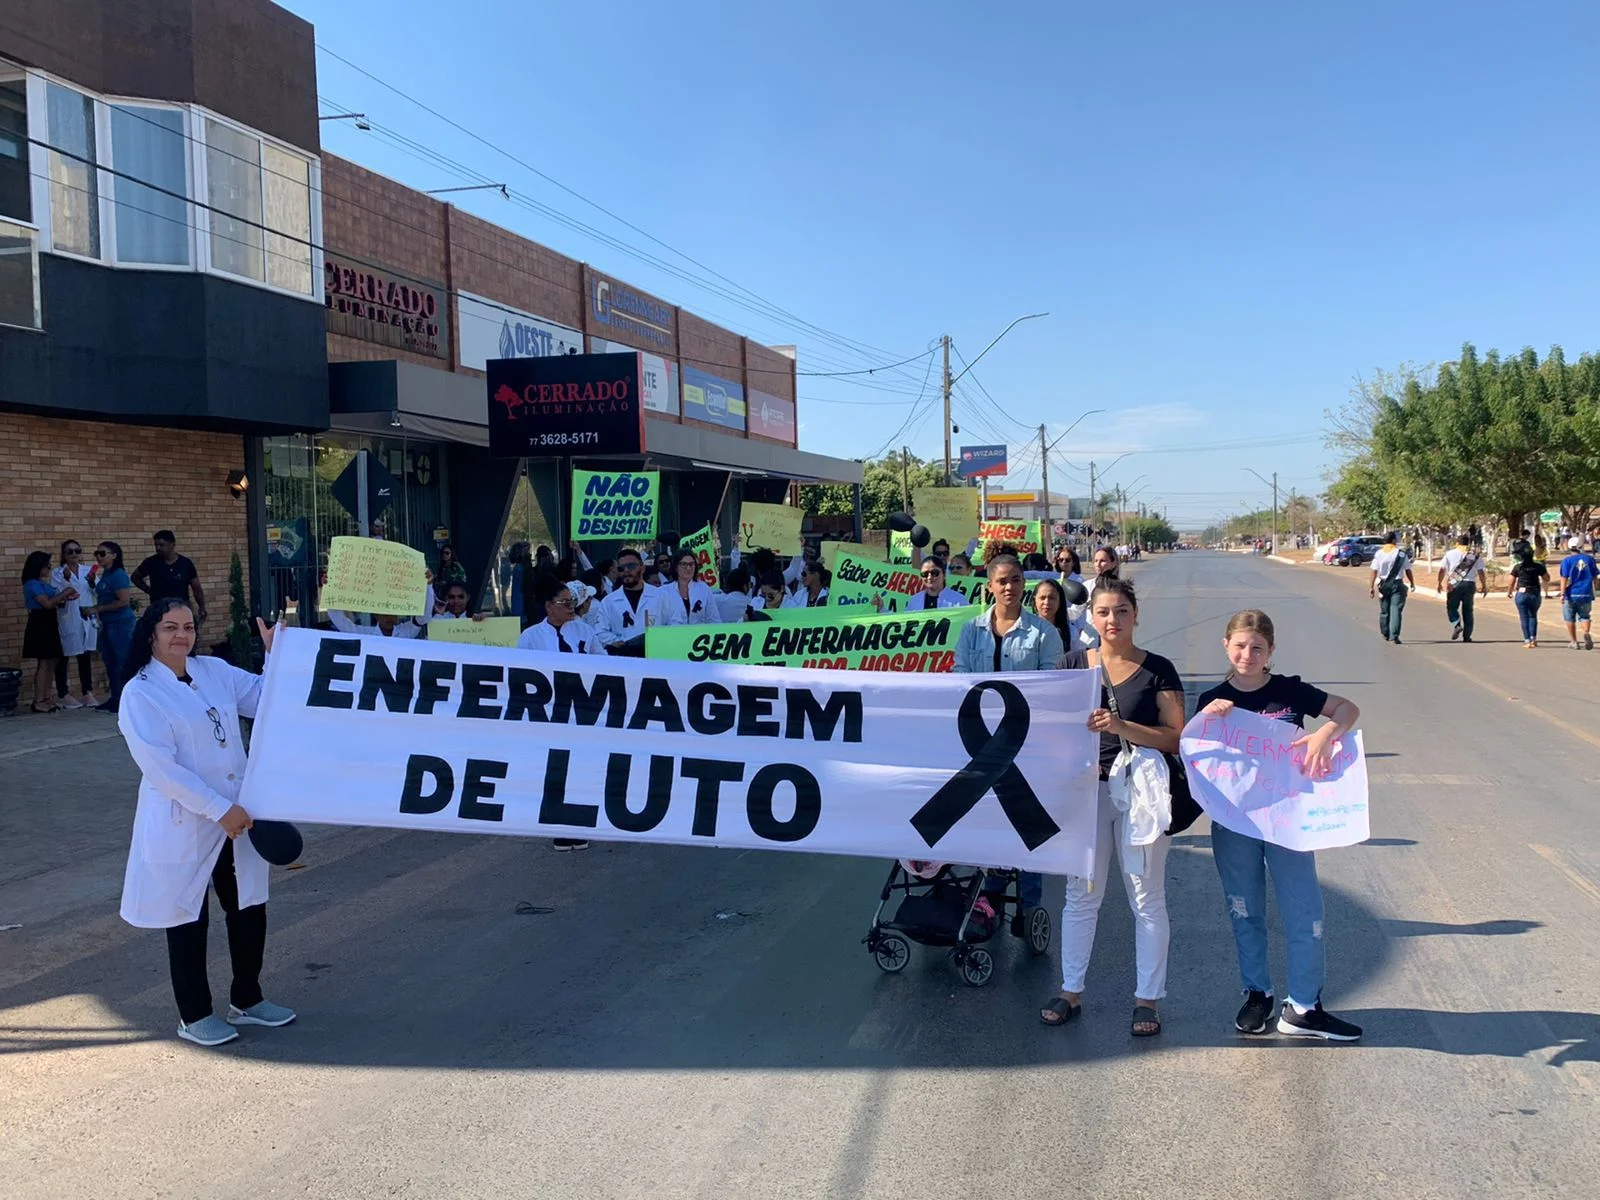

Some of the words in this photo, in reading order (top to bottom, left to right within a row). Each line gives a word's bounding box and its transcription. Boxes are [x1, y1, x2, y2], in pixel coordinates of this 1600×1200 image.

[327, 296, 438, 336] LUMINAÇÃO
[515, 322, 553, 357] OESTE
[524, 380, 628, 404] CERRADO
[524, 402, 629, 416] ILUMINAÇÃO
[529, 437, 538, 446] 77
[540, 432, 599, 445] 3628-5171
[585, 474, 650, 497] NÃO
[582, 498, 653, 516] VAMOS
[578, 516, 653, 535] DESISTIR!
[688, 633, 752, 662] SEM
[762, 618, 951, 657] ENFERMAGEM
[306, 638, 863, 743] ENFERMAGEM
[1197, 717, 1354, 778] ENFERMAM
[399, 753, 509, 822] DE
[538, 747, 822, 842] LUTO
